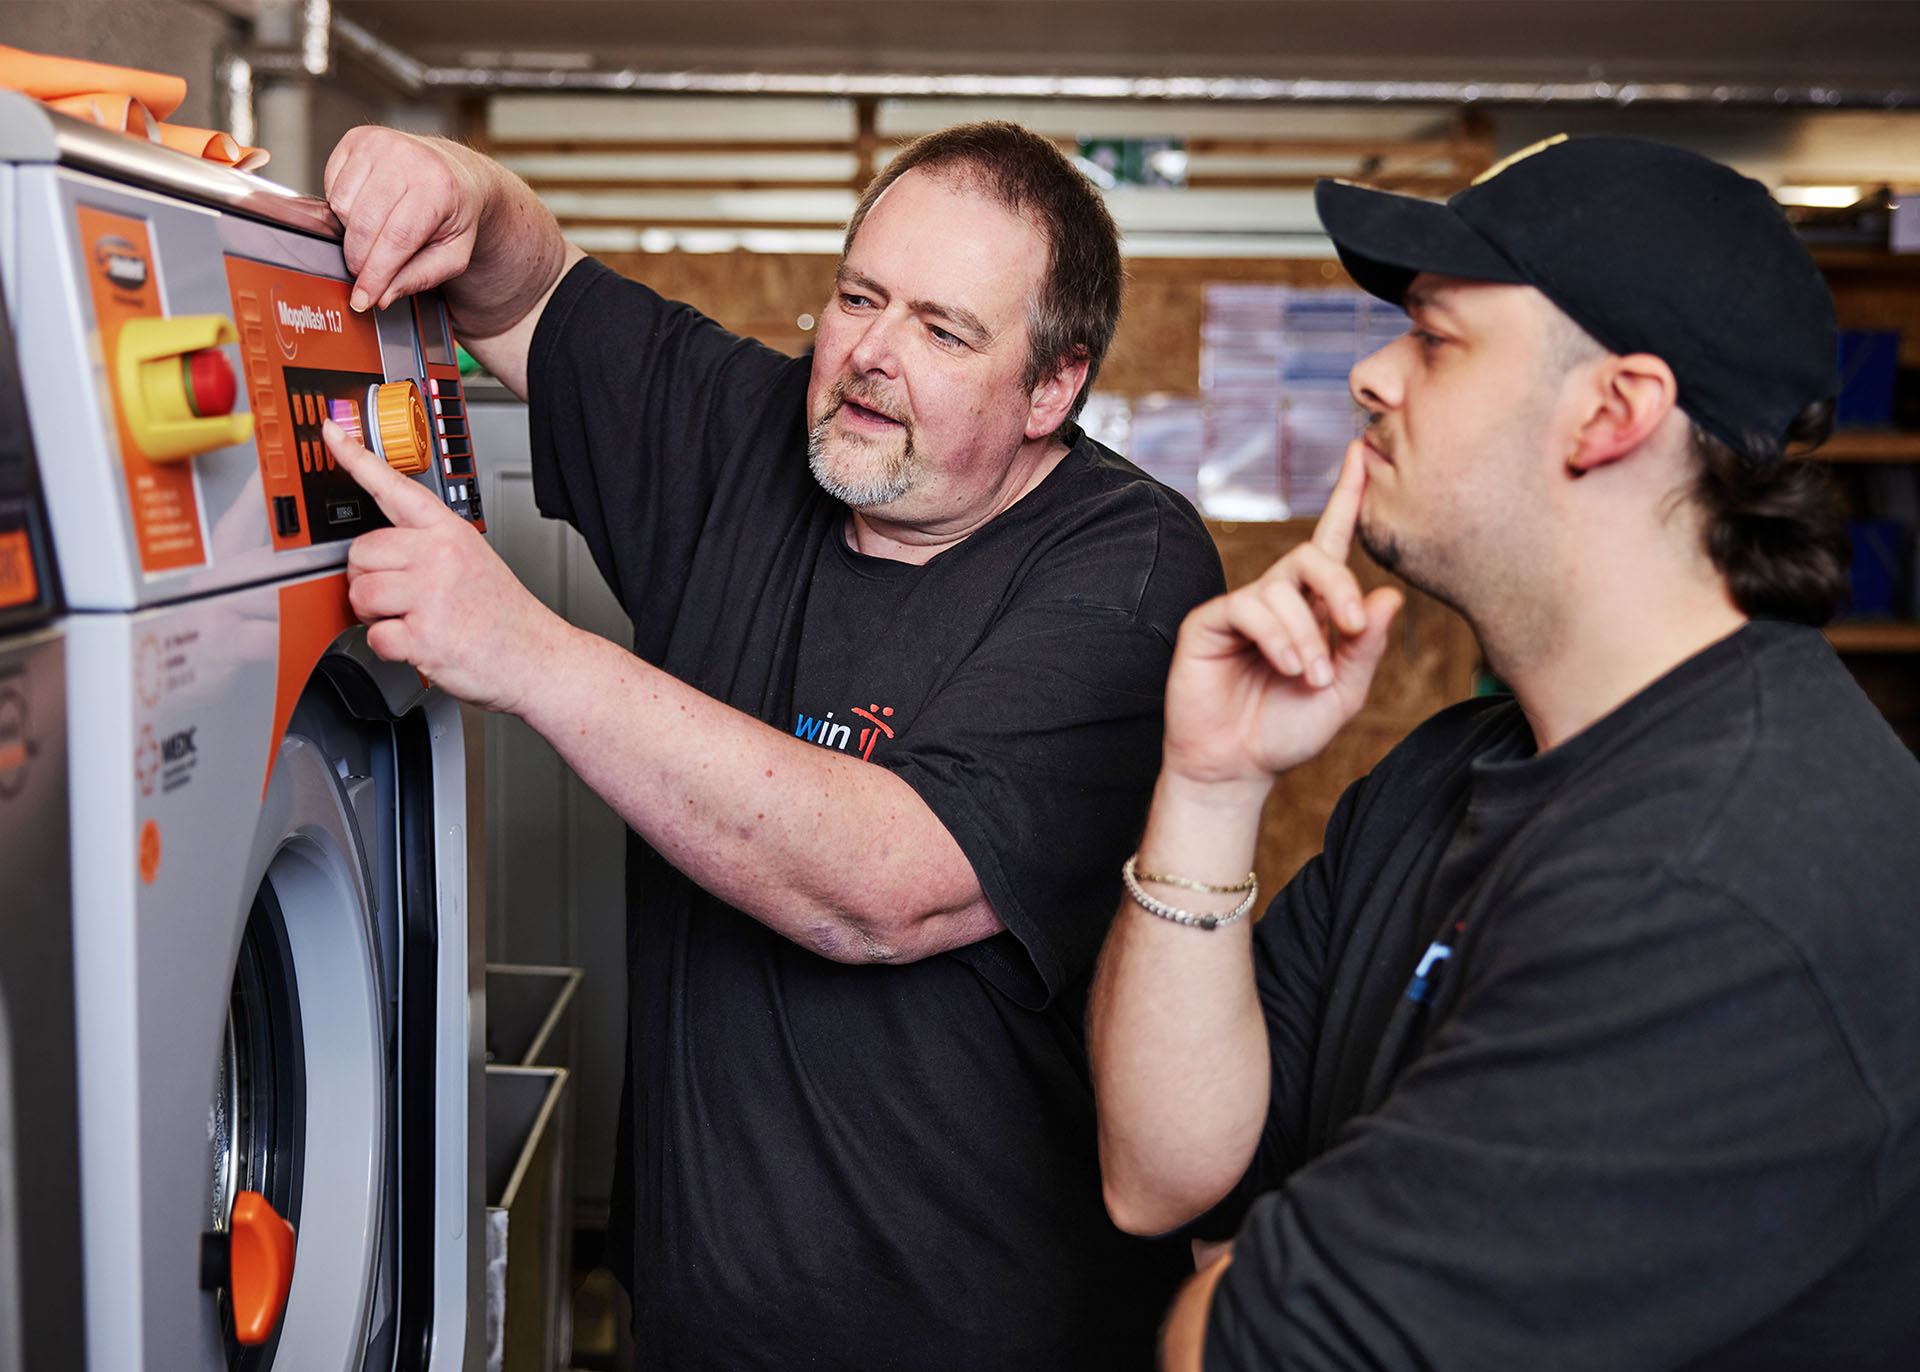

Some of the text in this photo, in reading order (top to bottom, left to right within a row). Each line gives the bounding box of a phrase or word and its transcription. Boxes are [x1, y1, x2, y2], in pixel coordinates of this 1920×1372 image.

[278, 300, 342, 334] MoppWash 11.7
[795, 711, 850, 750] win
